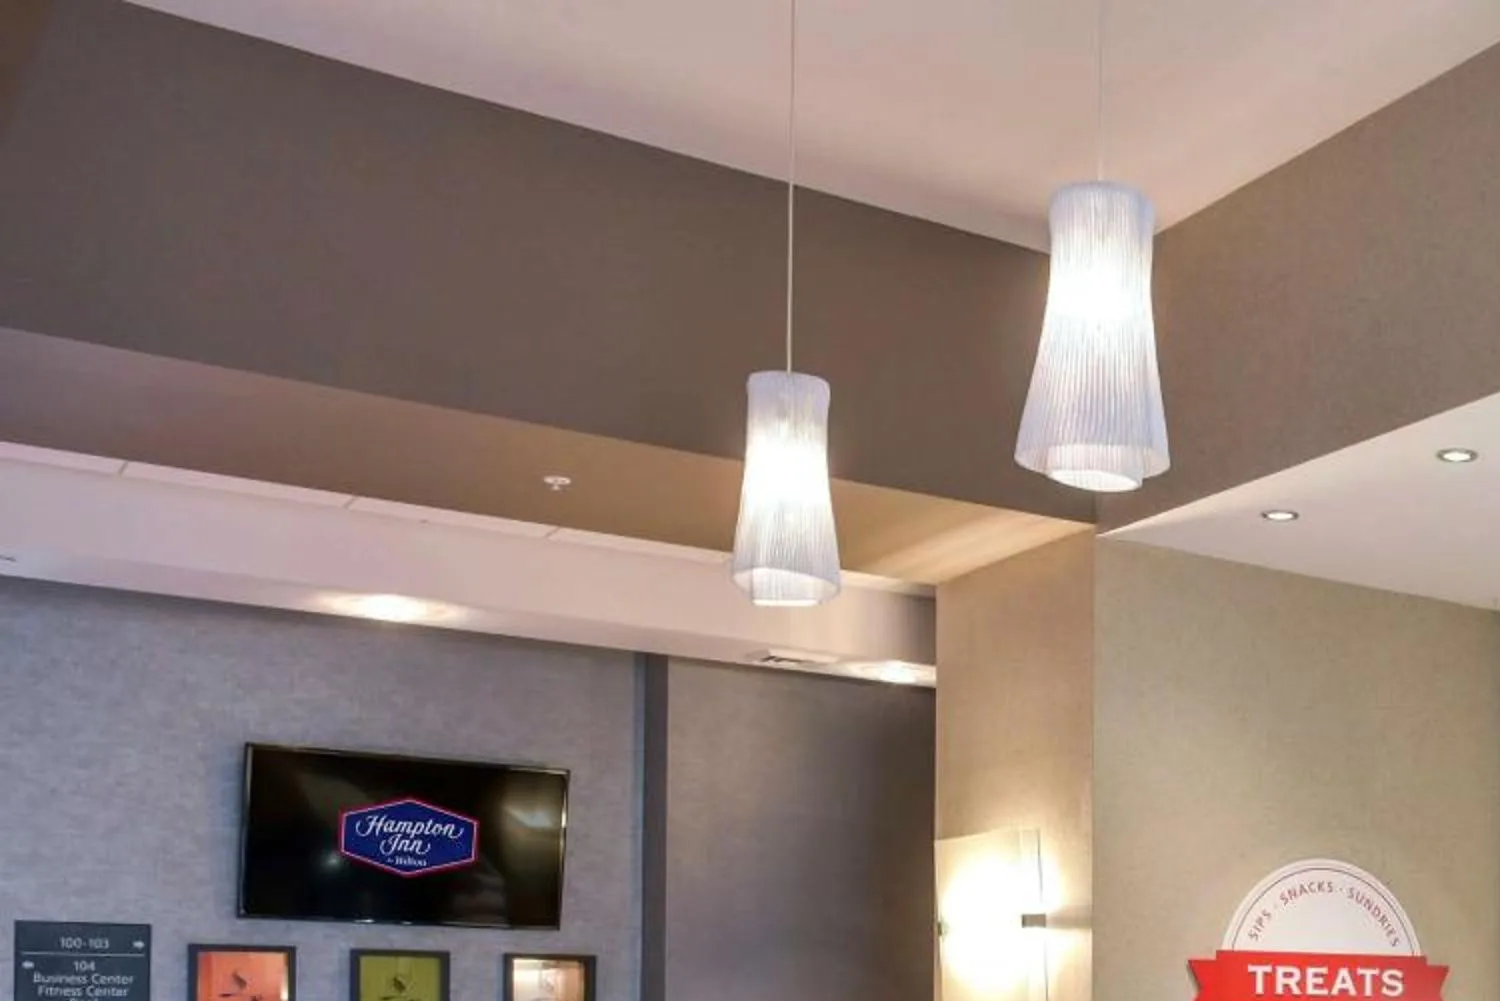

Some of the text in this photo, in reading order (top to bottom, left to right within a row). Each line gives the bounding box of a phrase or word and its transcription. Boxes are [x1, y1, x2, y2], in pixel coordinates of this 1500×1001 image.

[356, 814, 464, 839] Hampton
[380, 834, 431, 855] Inn
[1248, 881, 1400, 947] SIPS SNACKS SUNDRIES
[74, 960, 96, 971] 104
[33, 971, 134, 985] Business Center
[1247, 964, 1404, 997] TREATS
[38, 985, 129, 997] Fitness Center
